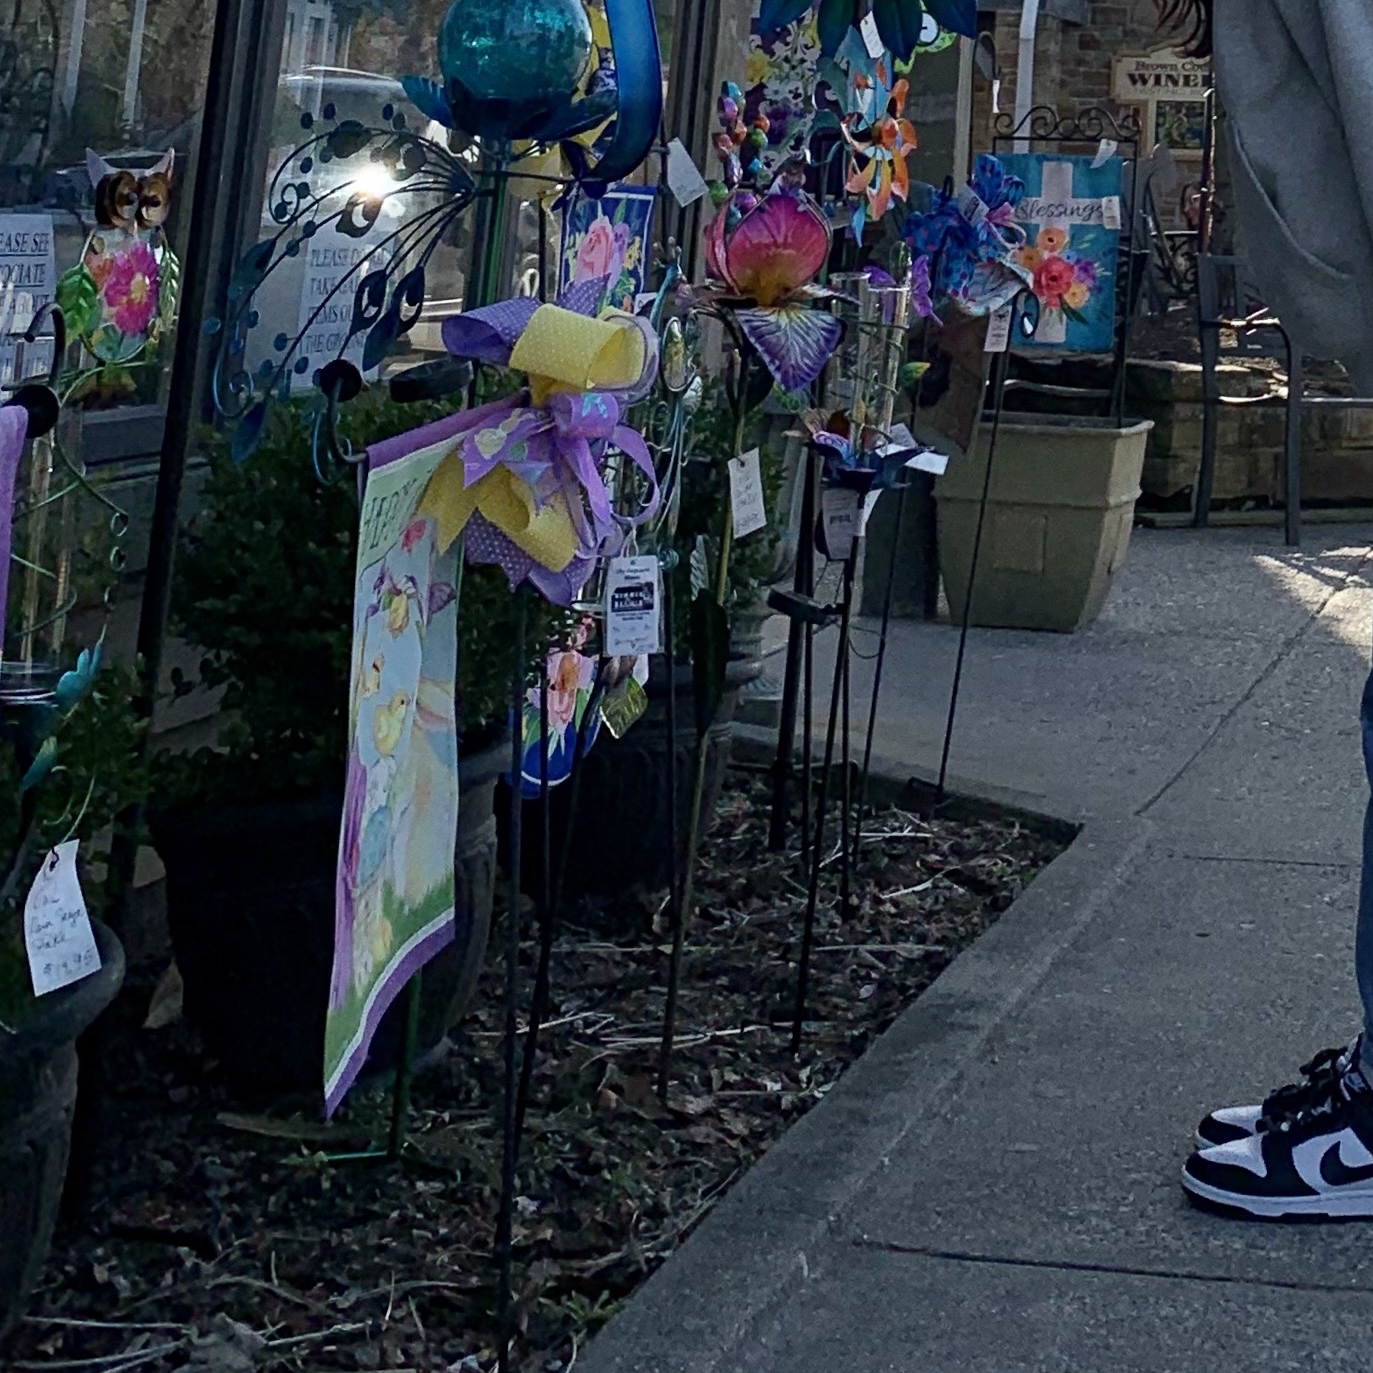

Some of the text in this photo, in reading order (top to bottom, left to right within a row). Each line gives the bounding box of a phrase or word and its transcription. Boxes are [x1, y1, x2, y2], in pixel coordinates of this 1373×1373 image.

[1127, 73, 1211, 87] WINE
[1014, 199, 1103, 221] Blessings
[31, 232, 50, 253] SEE
